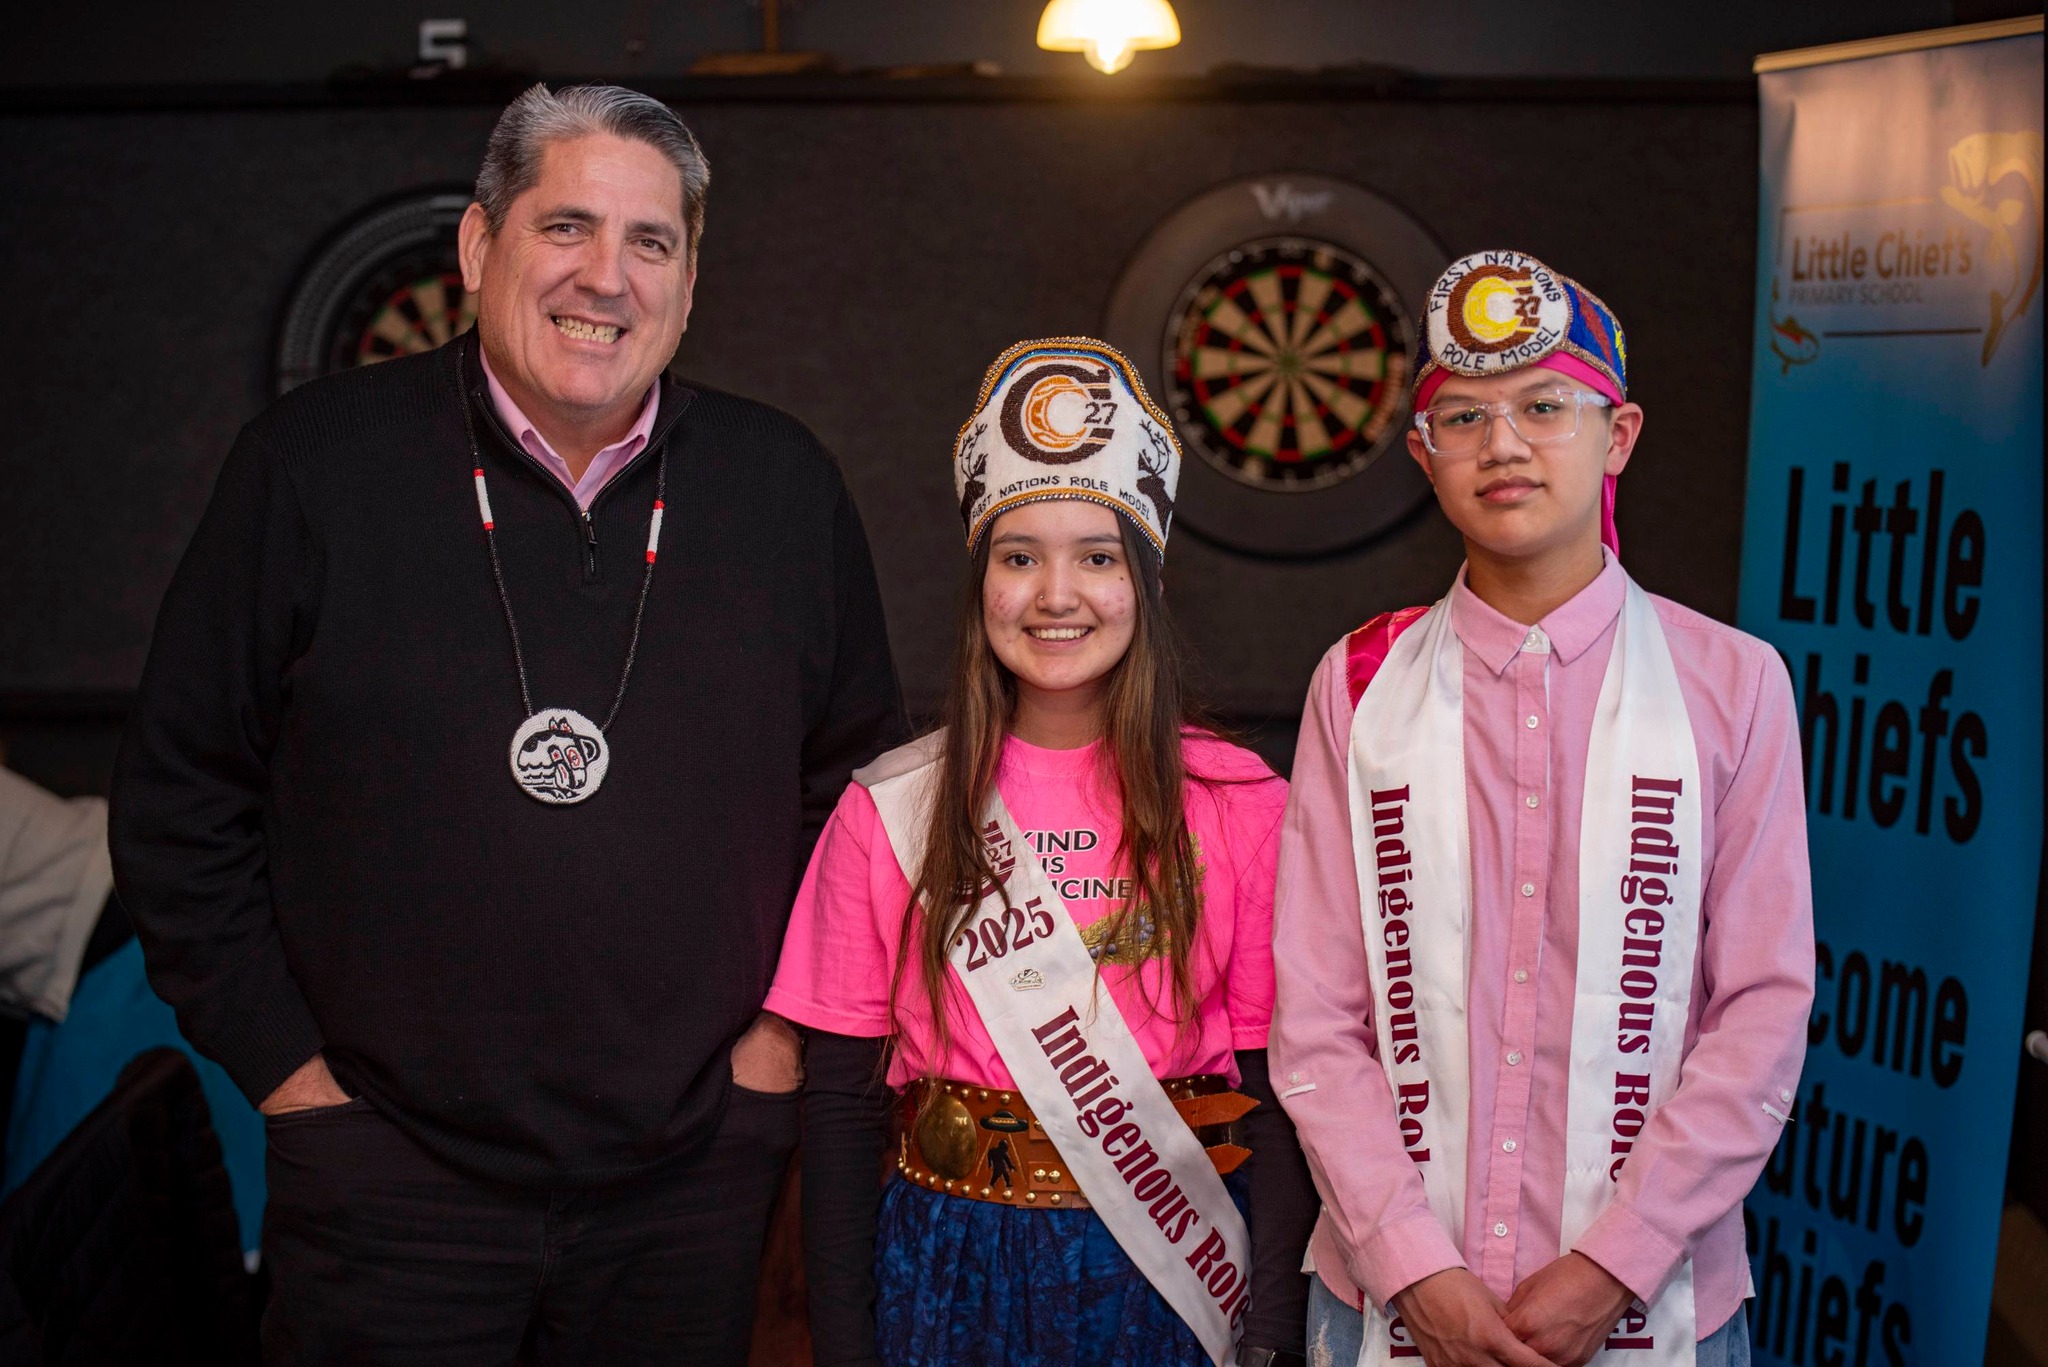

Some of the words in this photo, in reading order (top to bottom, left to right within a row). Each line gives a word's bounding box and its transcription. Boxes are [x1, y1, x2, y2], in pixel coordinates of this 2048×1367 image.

[1429, 257, 1473, 313] FIRST
[1484, 251, 1562, 303] NATIONS
[1791, 230, 1868, 282] Little
[1874, 225, 1973, 280] Chief's
[1789, 284, 1855, 306] PRIMARY
[1859, 281, 1924, 305] SCHOOL
[1441, 343, 1486, 371] ROLE
[1500, 326, 1561, 366] MODEL
[1083, 401, 1118, 425] 27
[972, 493, 992, 519] FIRST
[999, 474, 1061, 499] NATIONS
[1070, 476, 1109, 492] ROLE
[1118, 488, 1151, 521] MODEL
[1778, 461, 1986, 642] Little
[1777, 648, 1989, 846] hiefs
[1024, 829, 1098, 853] IND
[1041, 856, 1065, 874] IS
[955, 895, 1056, 974] 2025
[1617, 773, 1684, 1055] Indigenous
[1370, 783, 1421, 1065] Indigenous
[1398, 1079, 1431, 1183] Rol
[1808, 940, 1969, 1090] come
[1030, 1004, 1201, 1245] Indigenous
[1766, 1081, 1930, 1249] uture
[1744, 1207, 1912, 1367] hiefs
